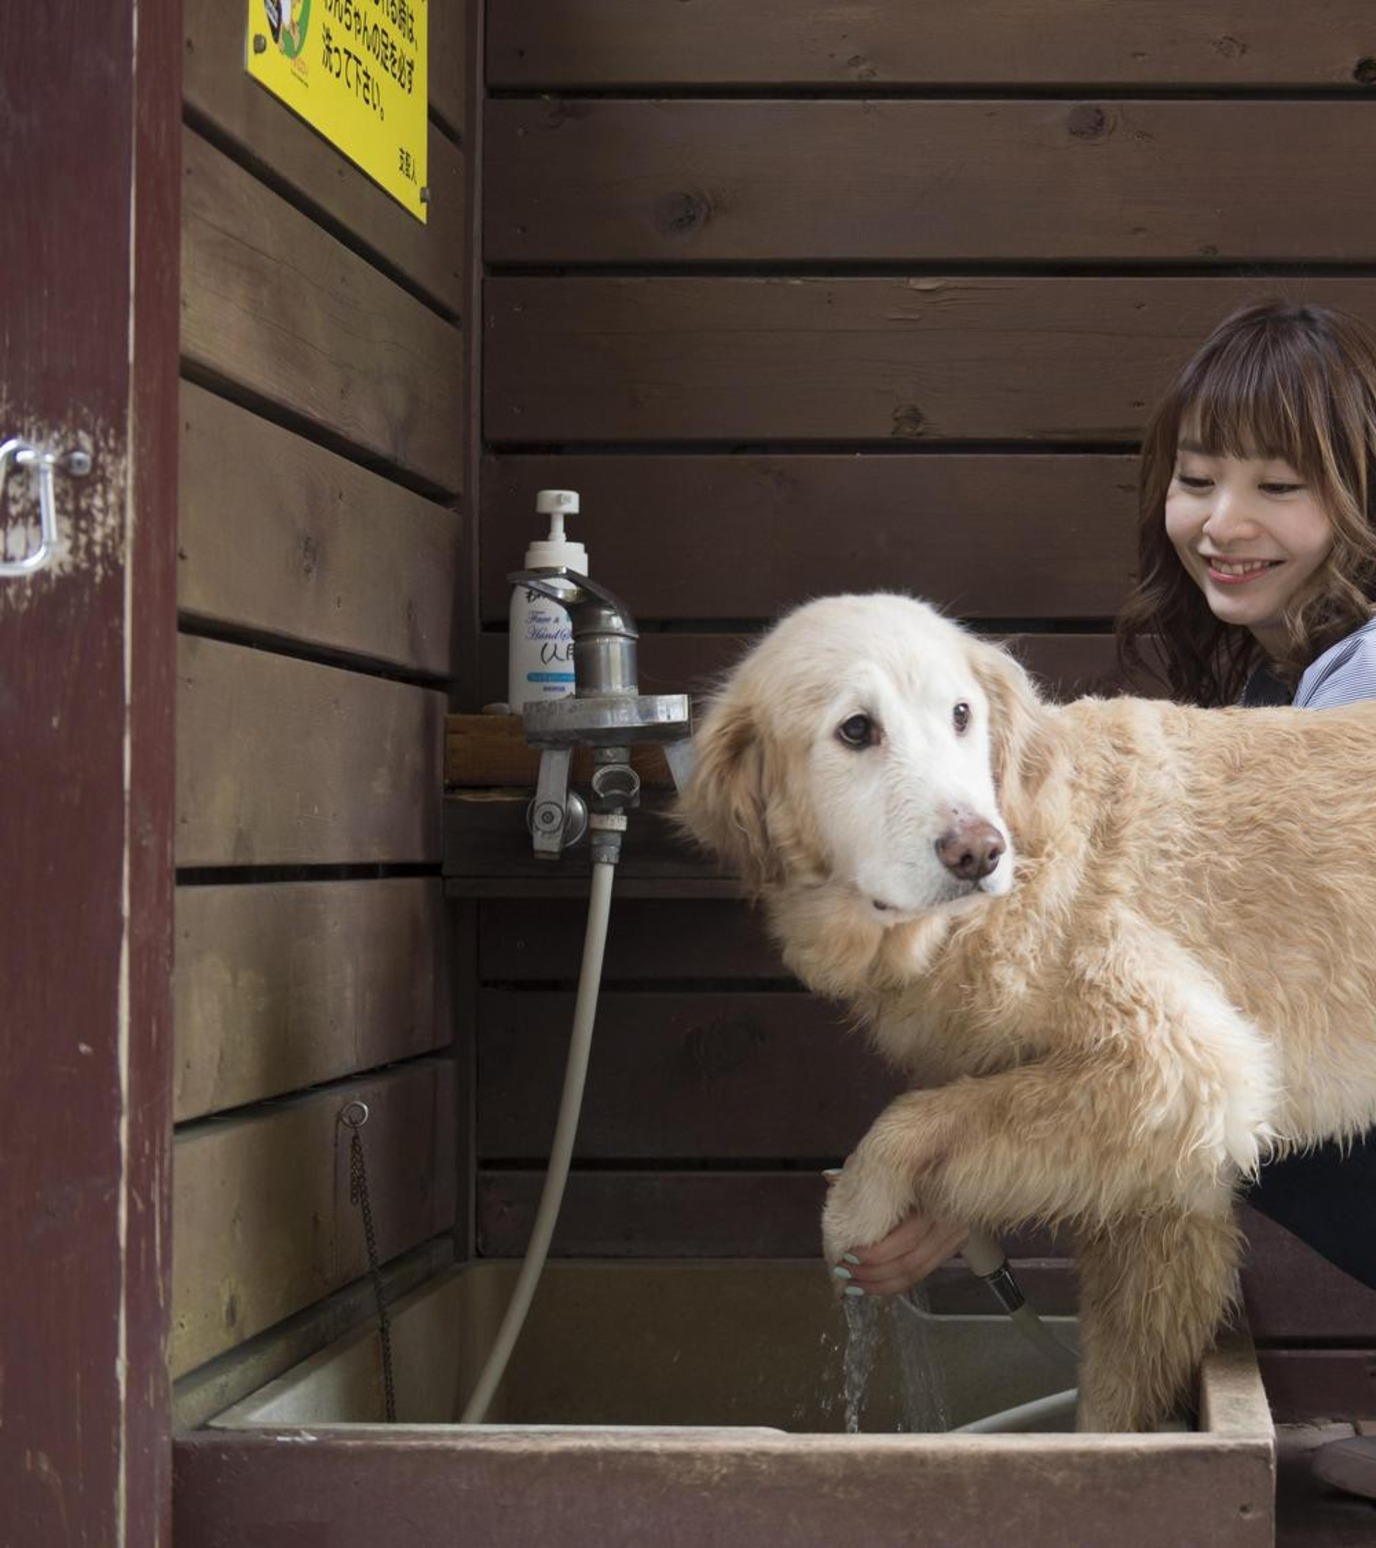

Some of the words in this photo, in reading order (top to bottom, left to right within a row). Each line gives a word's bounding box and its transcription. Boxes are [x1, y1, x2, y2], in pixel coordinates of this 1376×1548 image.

[322, 23, 385, 121] 洗って下さい。
[525, 626, 561, 641] Hand
